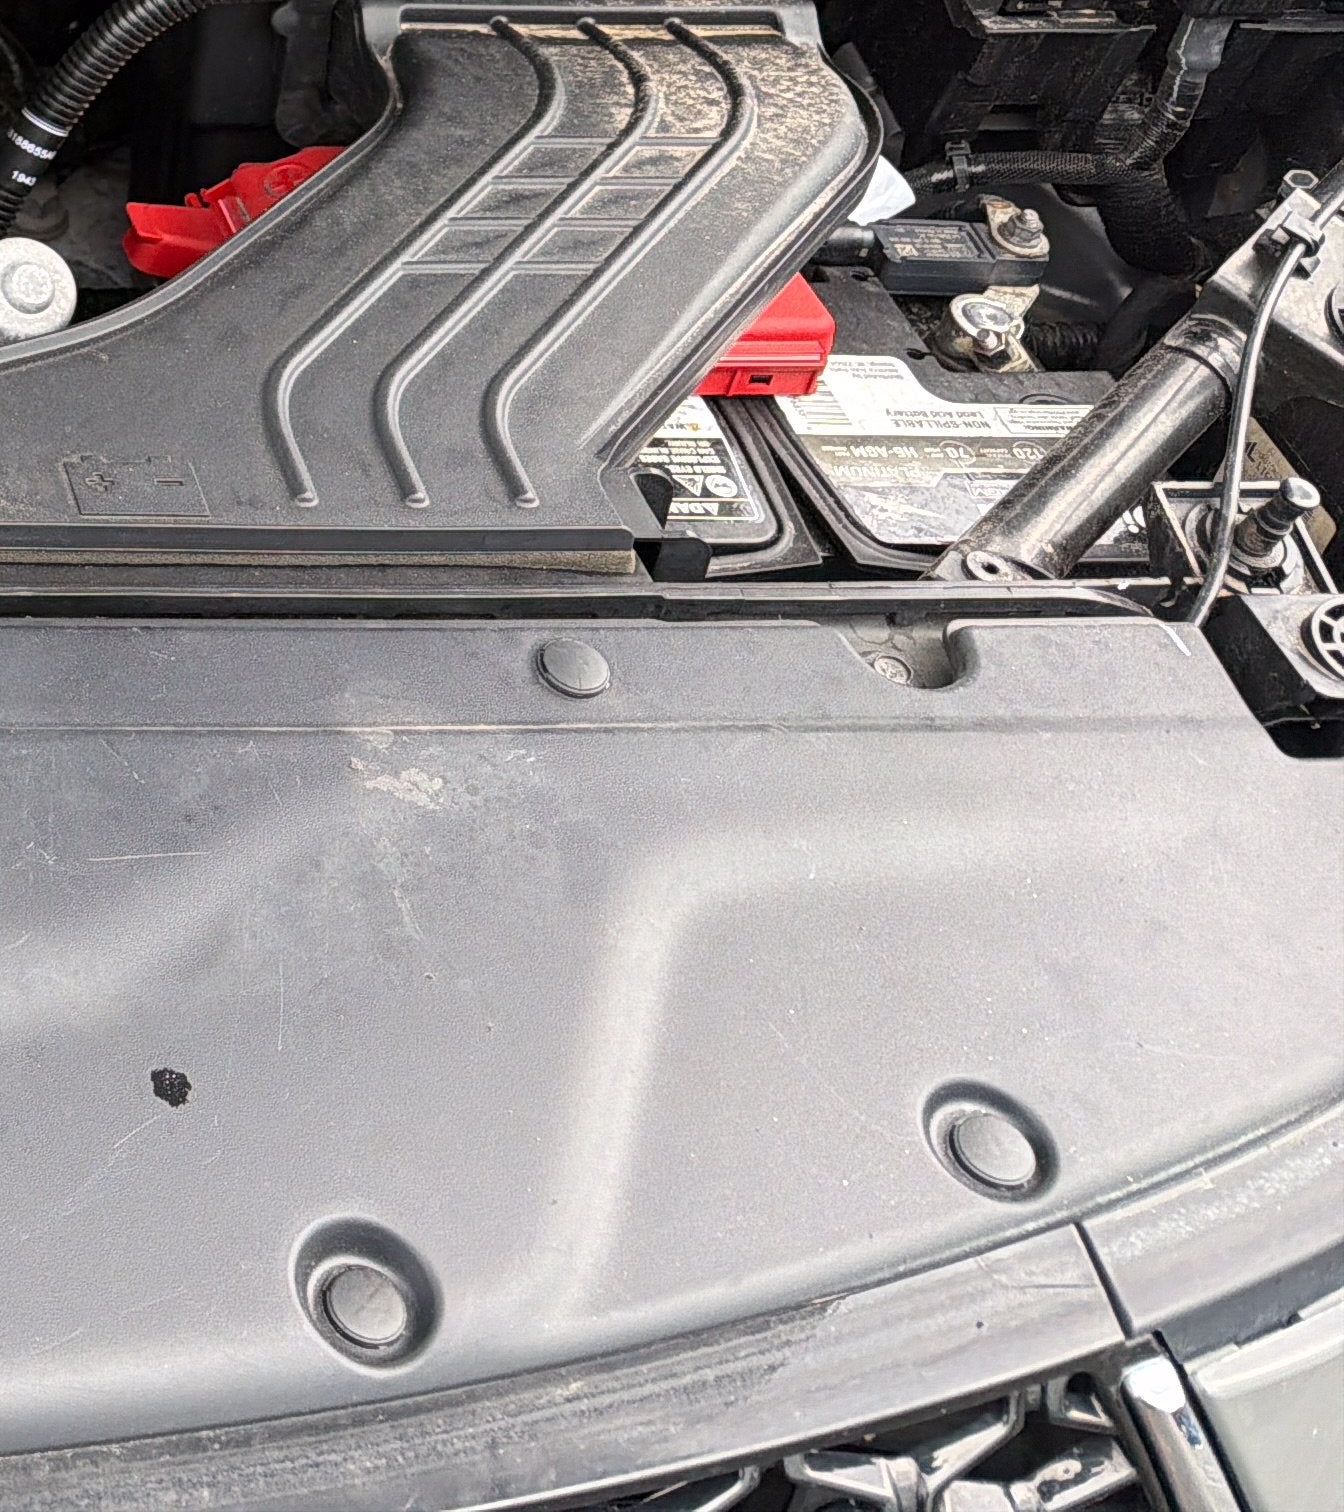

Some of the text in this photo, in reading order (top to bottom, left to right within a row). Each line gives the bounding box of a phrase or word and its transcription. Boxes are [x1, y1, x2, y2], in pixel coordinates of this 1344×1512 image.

[892, 418, 992, 430] NON-SPILLABLE
[850, 445, 919, 458] H6-AGM
[832, 464, 922, 479] PLATINUM
